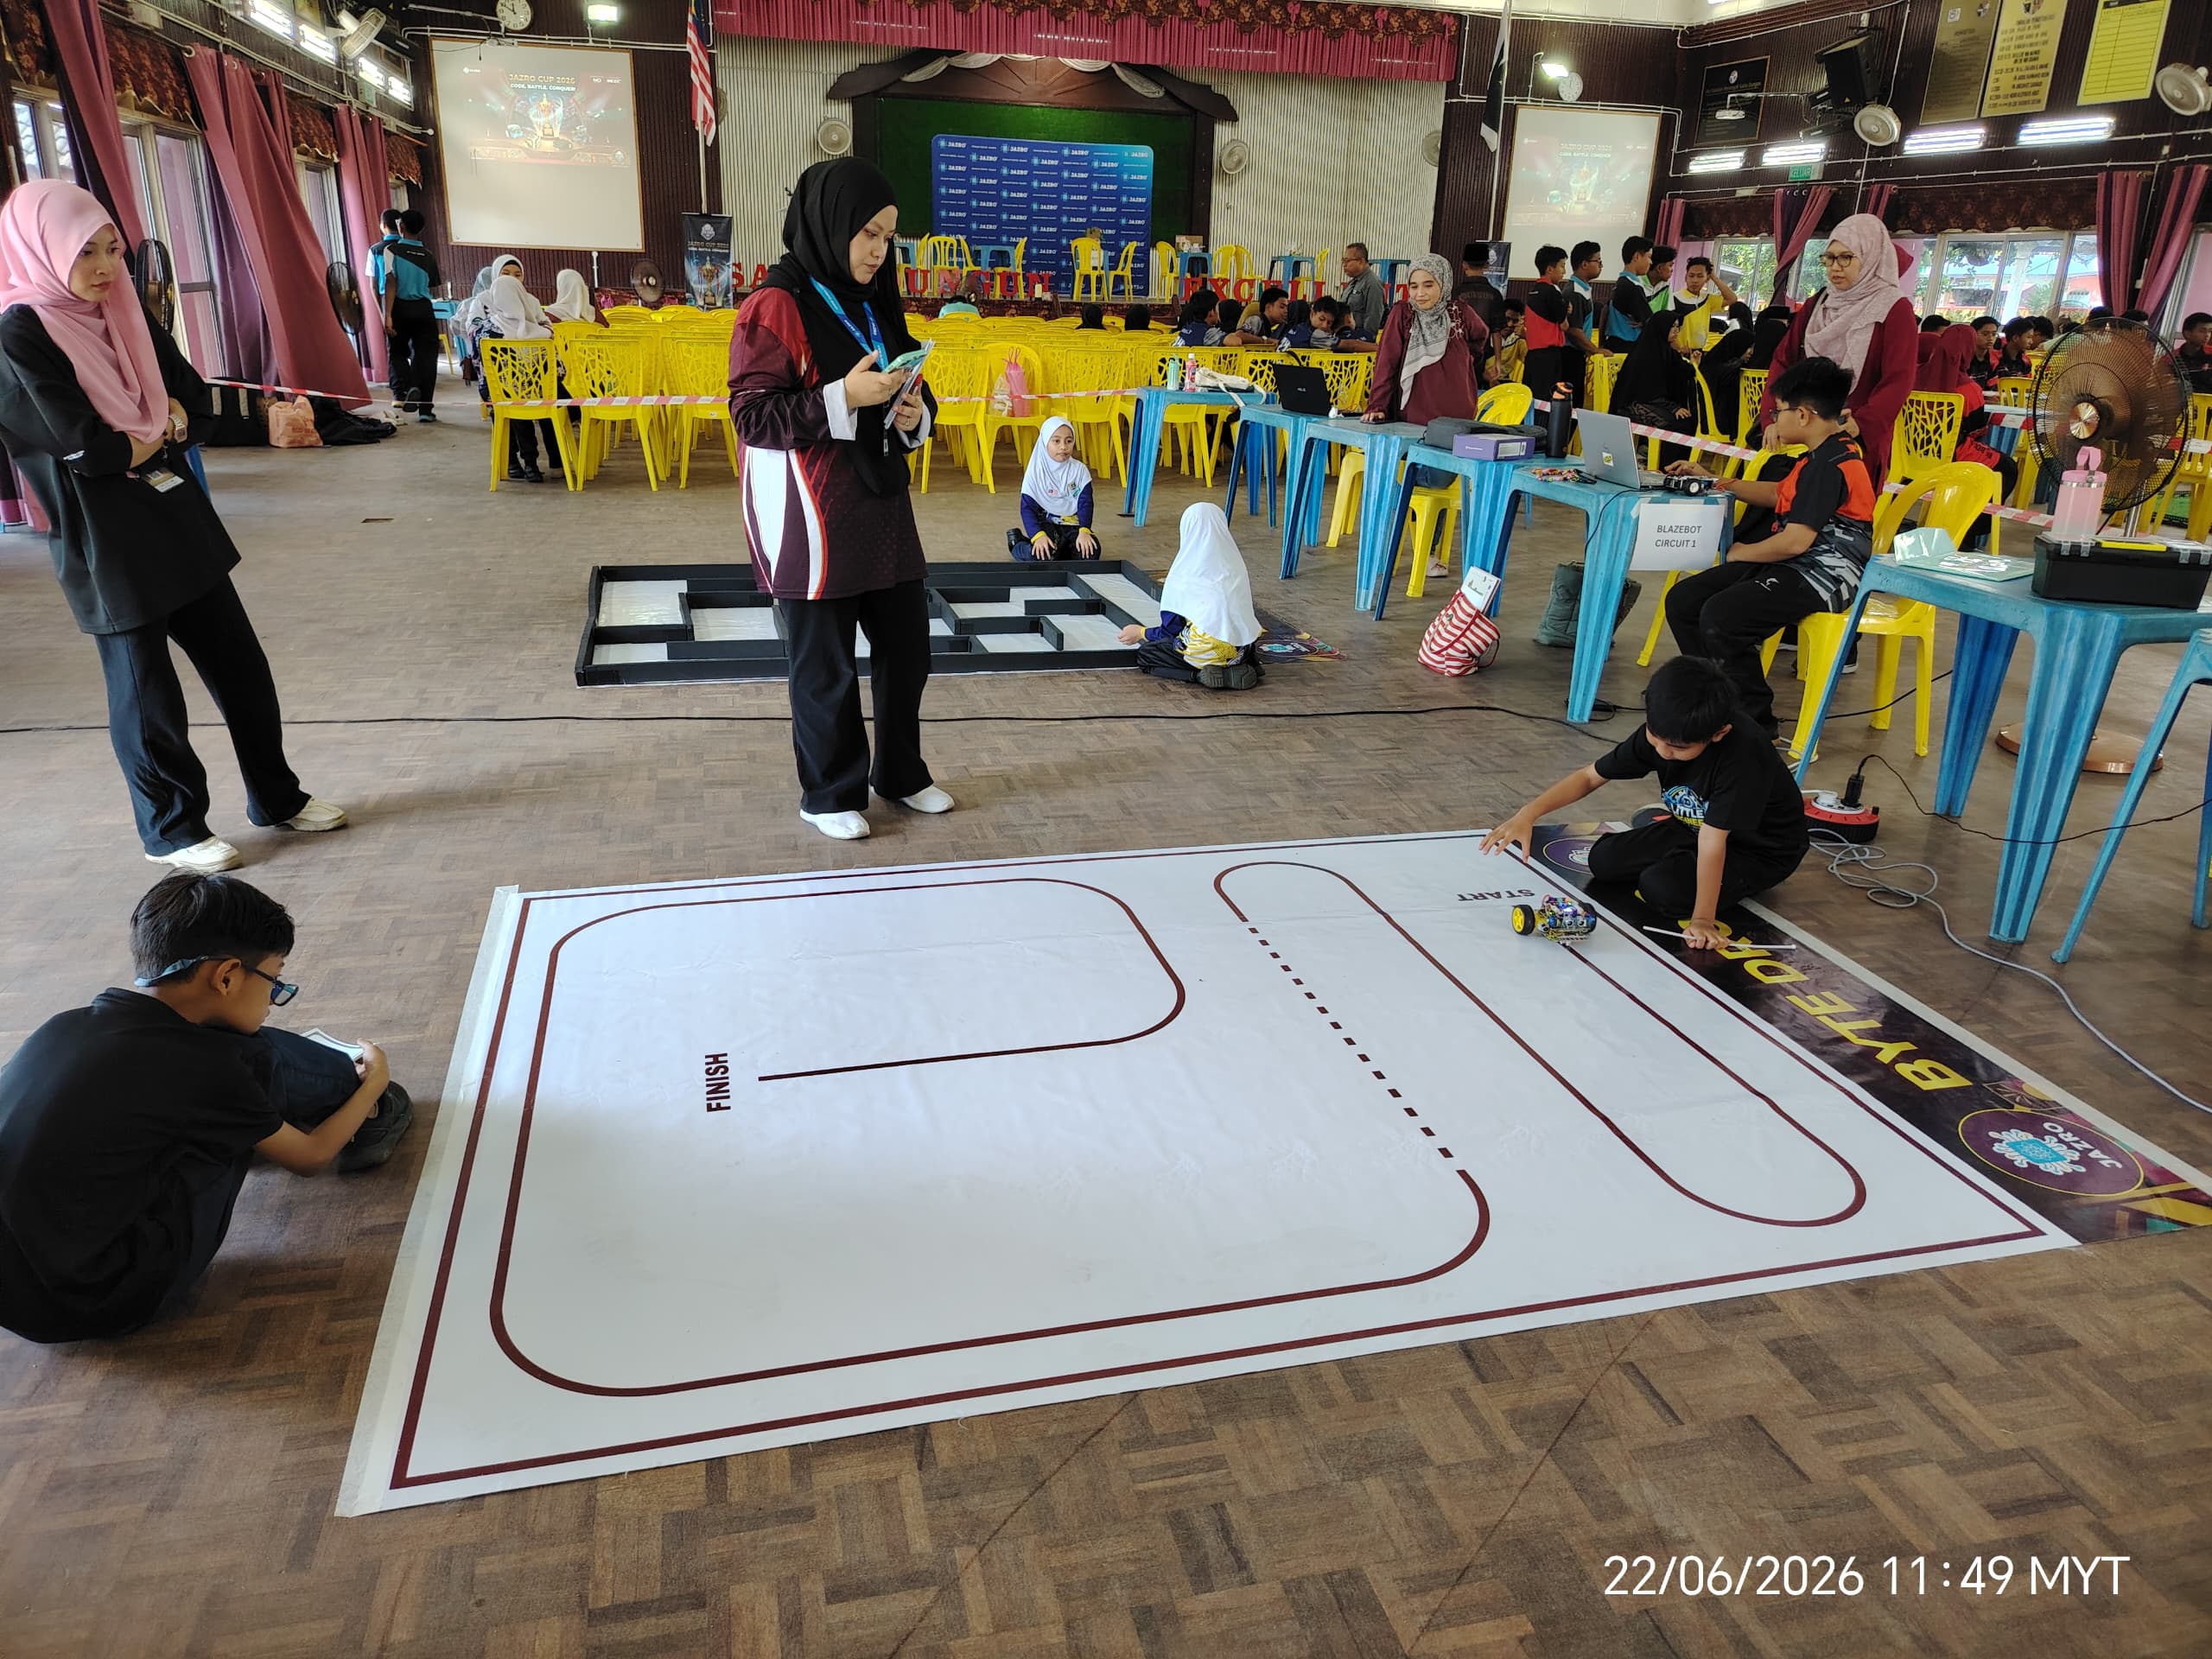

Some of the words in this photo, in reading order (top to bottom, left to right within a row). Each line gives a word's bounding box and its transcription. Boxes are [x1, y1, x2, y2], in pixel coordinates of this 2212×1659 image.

[1656, 524, 1702, 534] BLAZEBOT
[1655, 539, 1690, 548] CIRCUIT
[1691, 539, 1697, 548] 1
[1457, 889, 1535, 901] START
[704, 1052, 731, 1112] FINISH
[2043, 1122, 2123, 1168] JAZRO
